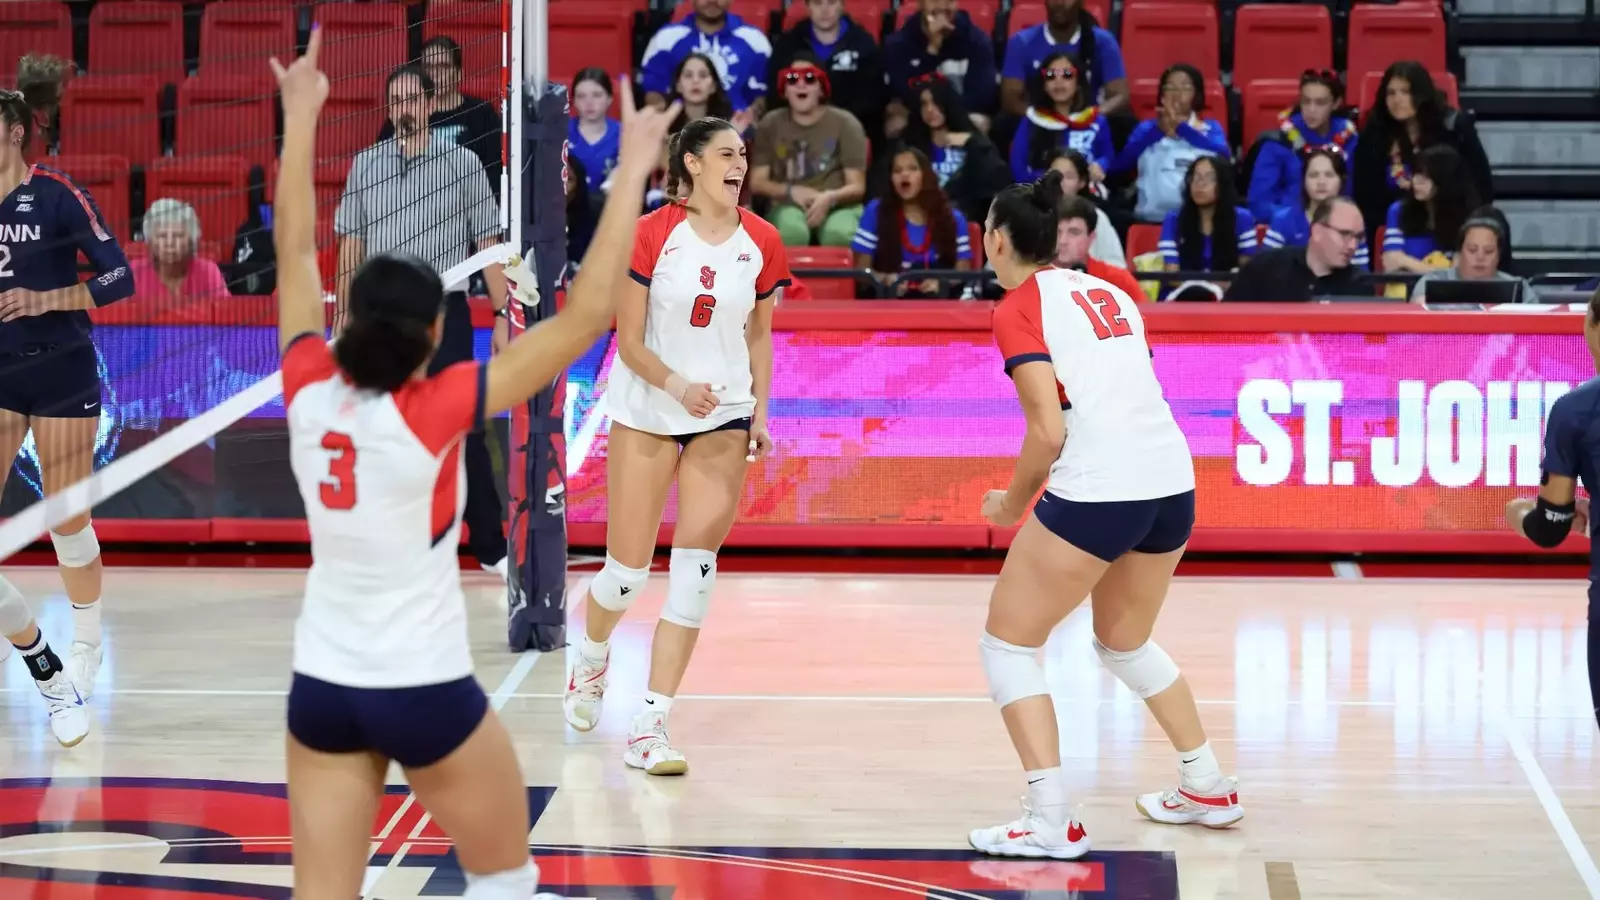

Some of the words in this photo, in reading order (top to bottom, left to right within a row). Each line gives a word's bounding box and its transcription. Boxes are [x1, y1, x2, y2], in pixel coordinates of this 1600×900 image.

[0, 223, 41, 243] NN
[690, 294, 716, 328] 6
[1070, 288, 1133, 340] 12
[1236, 379, 1355, 486] ST.
[1371, 380, 1570, 487] JOH
[319, 431, 358, 511] 3
